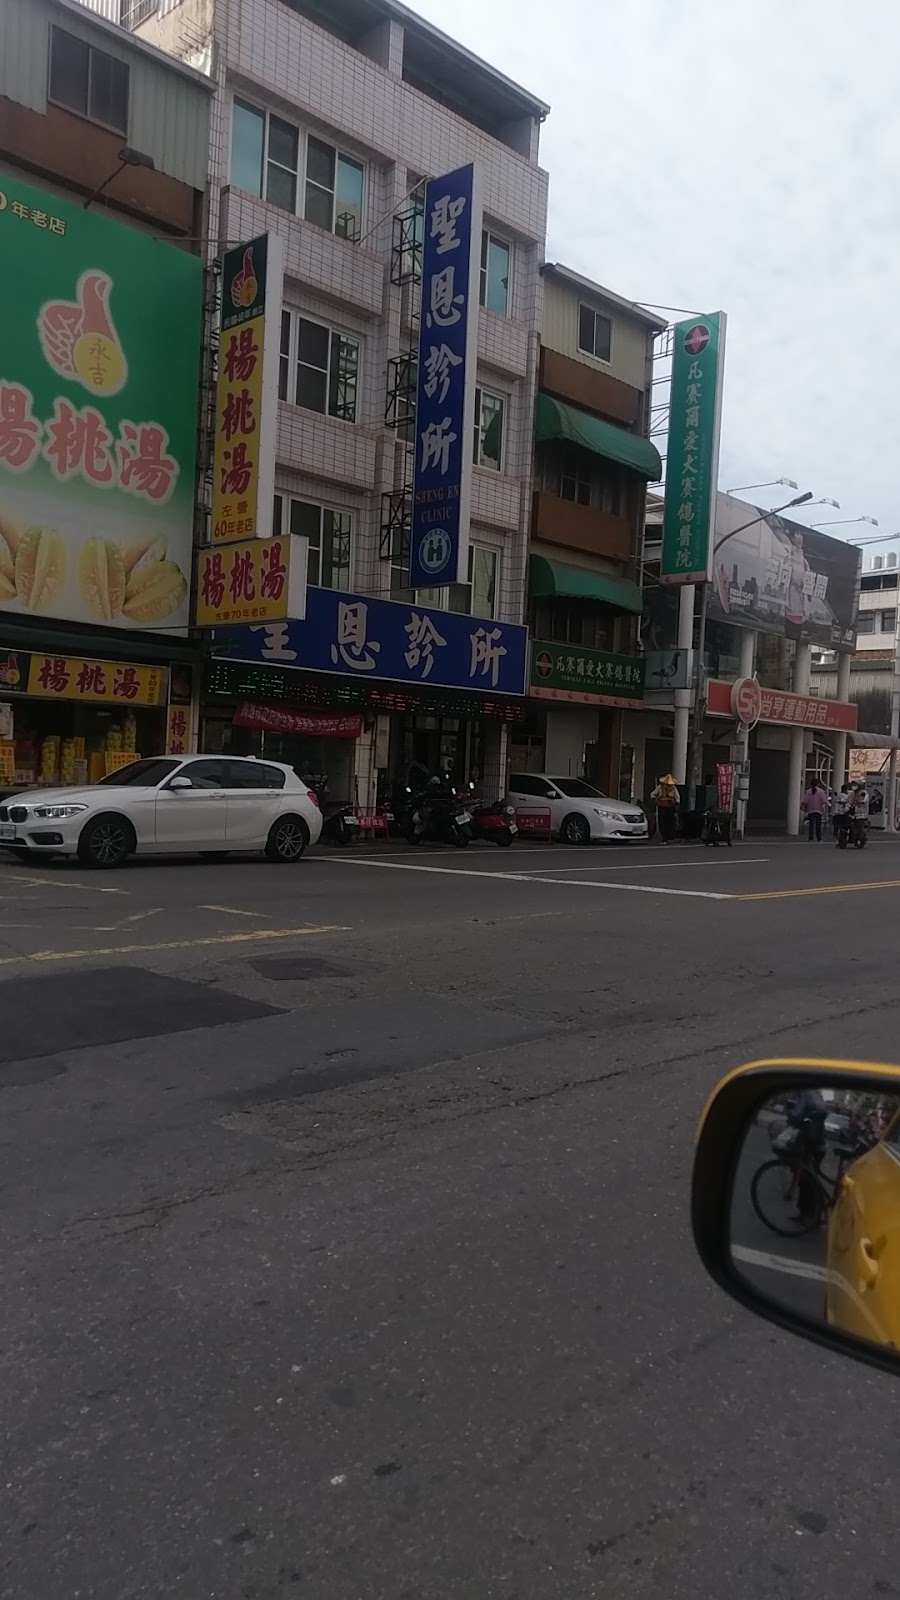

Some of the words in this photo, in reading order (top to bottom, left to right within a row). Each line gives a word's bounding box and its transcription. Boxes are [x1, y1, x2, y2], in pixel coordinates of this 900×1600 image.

[421, 195, 466, 475] 聖恩診所
[221, 327, 258, 496] 楊桃湯
[221, 501, 248, 517] 左營
[415, 487, 444, 504] SHENG
[447, 484, 460, 499] EN
[214, 518, 254, 538] 60年老店
[421, 506, 453, 523] CLINIC
[201, 542, 287, 609] 楊桃湯
[37, 658, 141, 700] 楊桃湯
